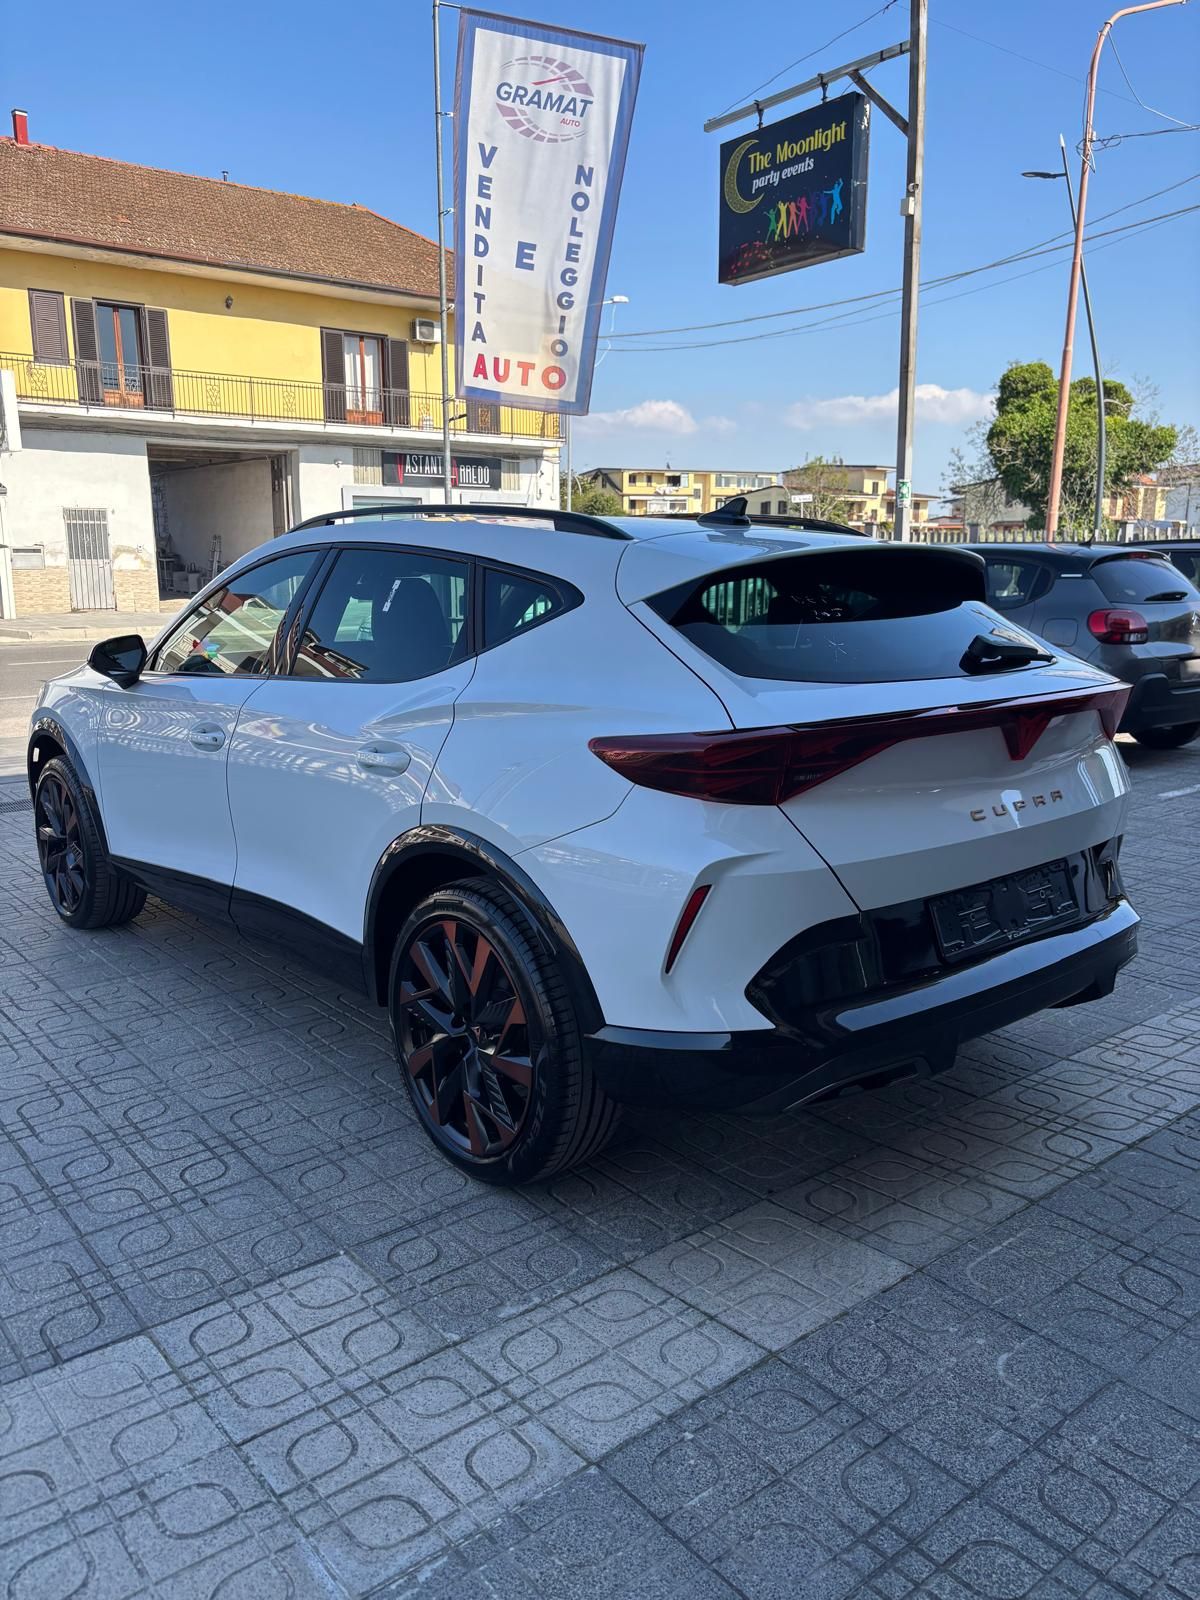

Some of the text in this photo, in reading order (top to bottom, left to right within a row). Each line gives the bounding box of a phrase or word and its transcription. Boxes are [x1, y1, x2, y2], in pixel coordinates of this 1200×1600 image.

[496, 82, 593, 118] GRAMAT
[560, 118, 581, 128] AUTO
[748, 121, 847, 174] The Moonlight
[752, 156, 814, 194] party events
[471, 142, 498, 344] VENDITA
[515, 240, 537, 271] E
[550, 164, 594, 357] NOLEGGIO
[473, 353, 566, 390] AUTO
[397, 453, 444, 485] VASTANT
[970, 790, 1063, 822] CUPRA
